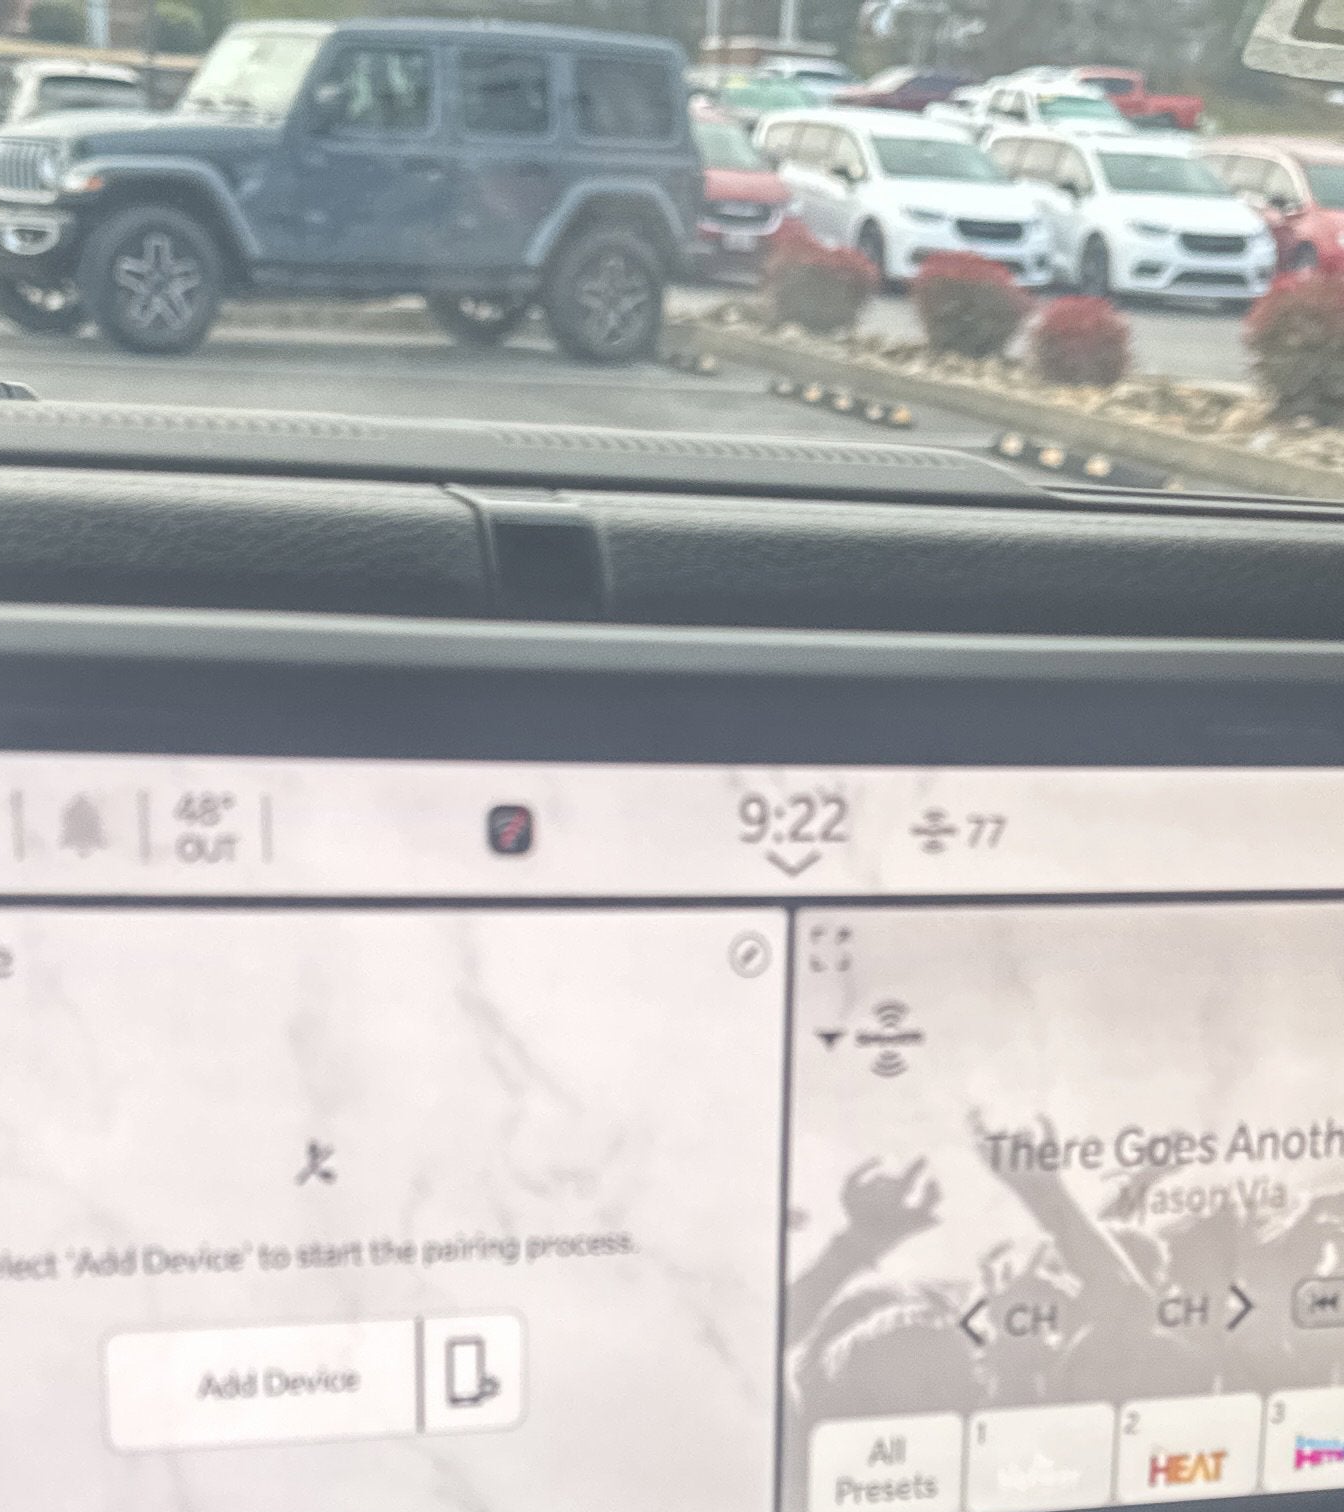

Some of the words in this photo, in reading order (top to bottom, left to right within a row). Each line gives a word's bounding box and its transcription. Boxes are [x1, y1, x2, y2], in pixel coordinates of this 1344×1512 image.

[739, 793, 850, 844] 9:22
[967, 814, 1007, 849] 77
[985, 1132, 1105, 1173] There
[1114, 1126, 1218, 1169] Goes
[259, 1242, 291, 1270] to
[296, 1239, 362, 1268] start
[369, 1235, 417, 1265] the
[422, 1229, 520, 1269] pairing
[1006, 1304, 1056, 1336] CH
[1158, 1297, 1207, 1327] CH
[197, 1370, 257, 1400] Add
[264, 1367, 361, 1397] Device
[1123, 1411, 1141, 1435] 2
[1270, 1401, 1286, 1424] 3
[867, 1434, 906, 1467] All
[1147, 1450, 1227, 1487] HEAT
[834, 1474, 939, 1506] Presets
